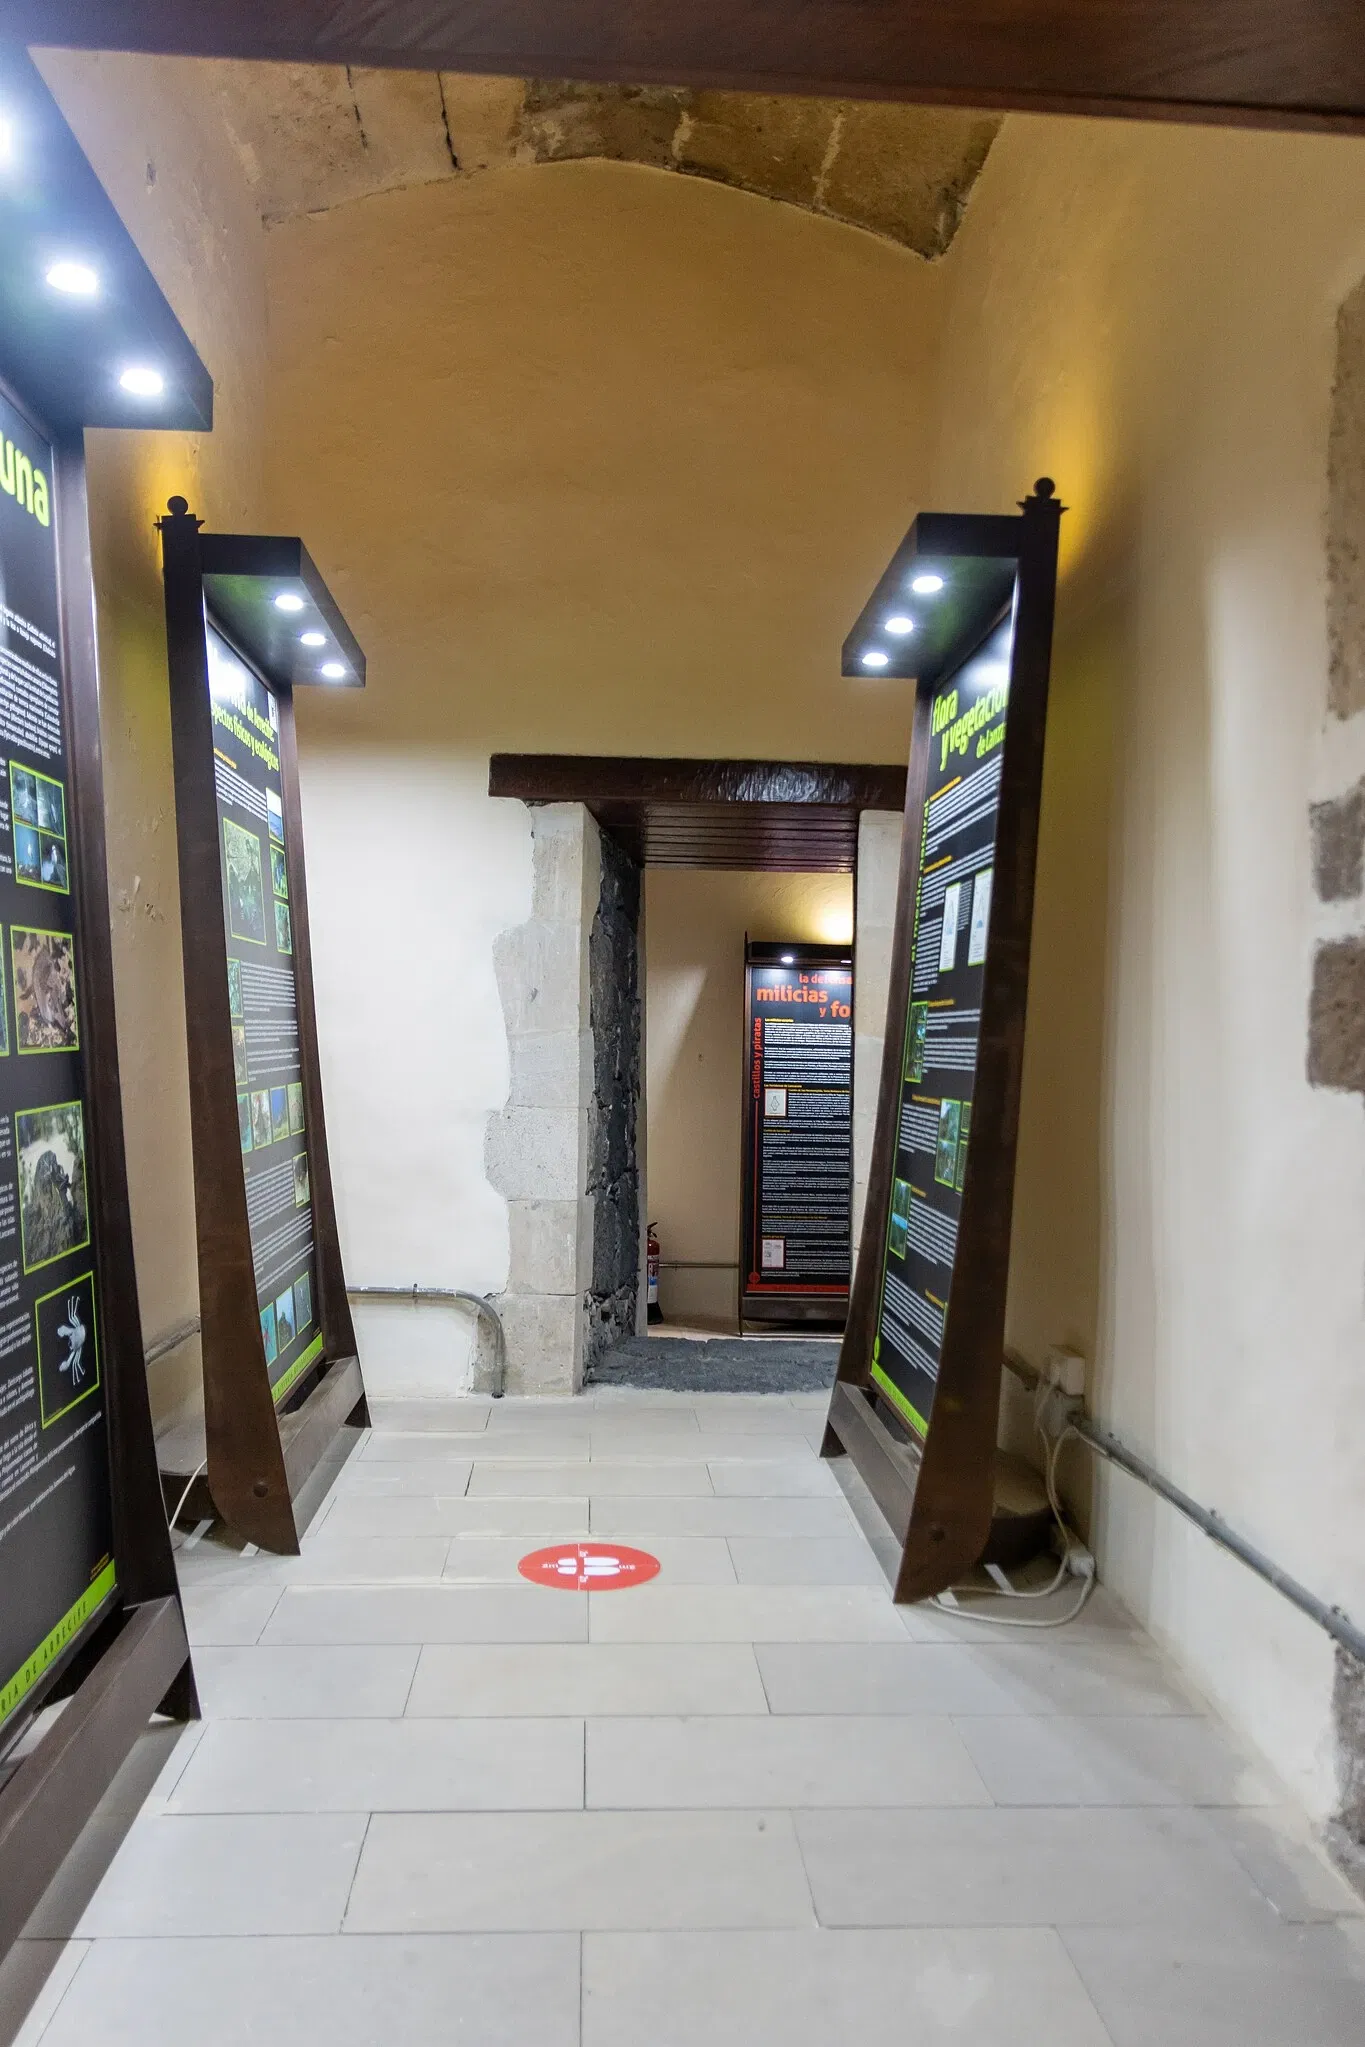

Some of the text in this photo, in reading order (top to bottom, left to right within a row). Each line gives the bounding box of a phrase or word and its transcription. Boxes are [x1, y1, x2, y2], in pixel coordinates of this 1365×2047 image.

[932, 689, 959, 736] flora
[940, 730, 950, 772] y
[756, 984, 829, 1003] milicias
[799, 973, 809, 984] la
[819, 1000, 851, 1018] y fo
[752, 1018, 764, 1099] castillos y piratas
[43, 1600, 87, 1662] ARRECIFE
